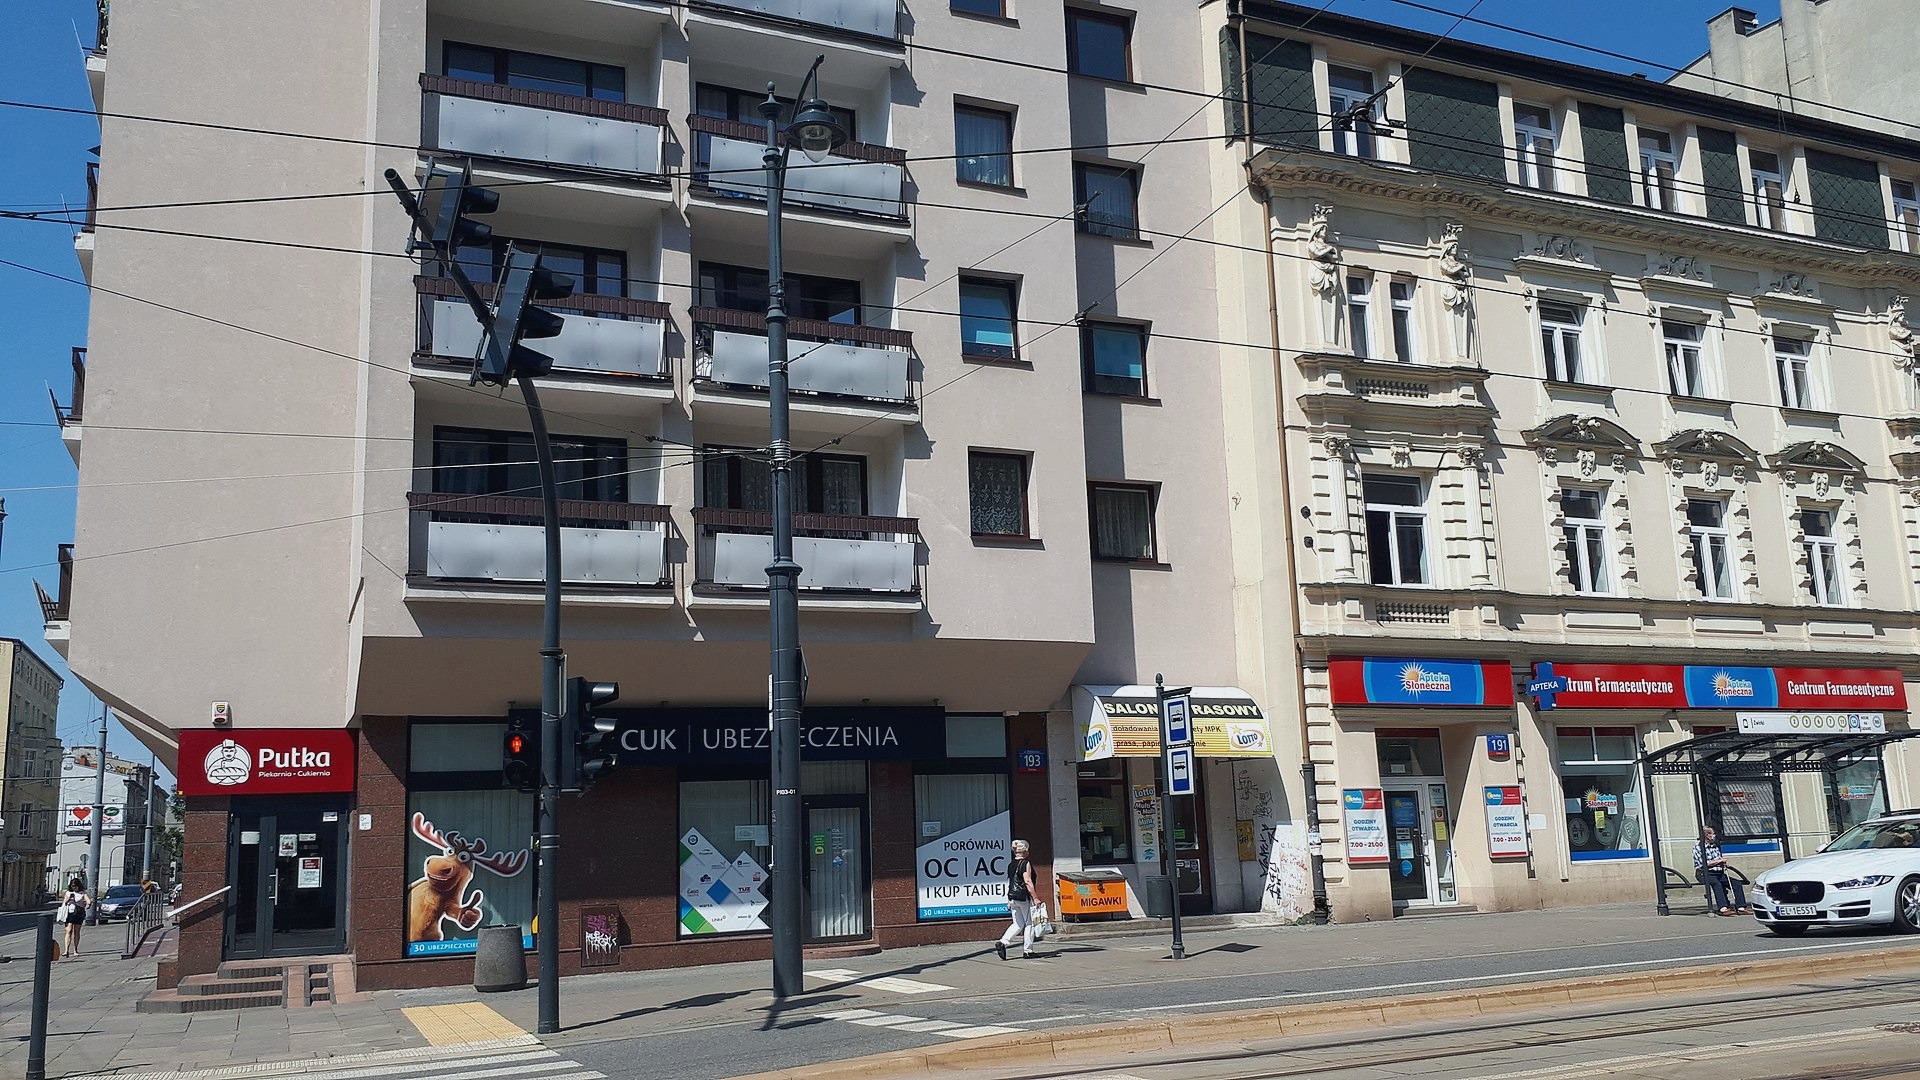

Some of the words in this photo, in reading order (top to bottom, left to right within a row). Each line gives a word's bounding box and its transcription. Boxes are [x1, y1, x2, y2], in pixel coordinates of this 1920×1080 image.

[1420, 673, 1449, 682] Apteka
[1406, 681, 1450, 690] Słoneczna
[1530, 681, 1558, 692] APTEKA
[1566, 678, 1593, 692] trum
[1595, 677, 1673, 695] Farmaceutyczne
[1728, 680, 1751, 689] Apteka
[1788, 681, 1826, 695] Centrum
[1826, 682, 1894, 697] Farmaceutyczne
[1104, 704, 1159, 714] SALON
[1190, 705, 1258, 715] RASOWY
[621, 728, 676, 751] CUK
[703, 726, 898, 749] UBEZECZENIA
[1084, 730, 1102, 751] LOTTO
[1237, 733, 1257, 745] LOTTO
[1492, 739, 1507, 751] 191
[259, 747, 331, 768] Putka
[1024, 754, 1041, 767] 193
[944, 838, 1004, 852] PORÓWNAJ
[924, 857, 959, 879] OC
[973, 856, 1005, 877] AC
[926, 887, 930, 899] I
[934, 885, 960, 898] KUP
[963, 883, 1006, 898] TANIEJ
[1080, 897, 1122, 907] MIGAWKI
[414, 944, 425, 952] 30
